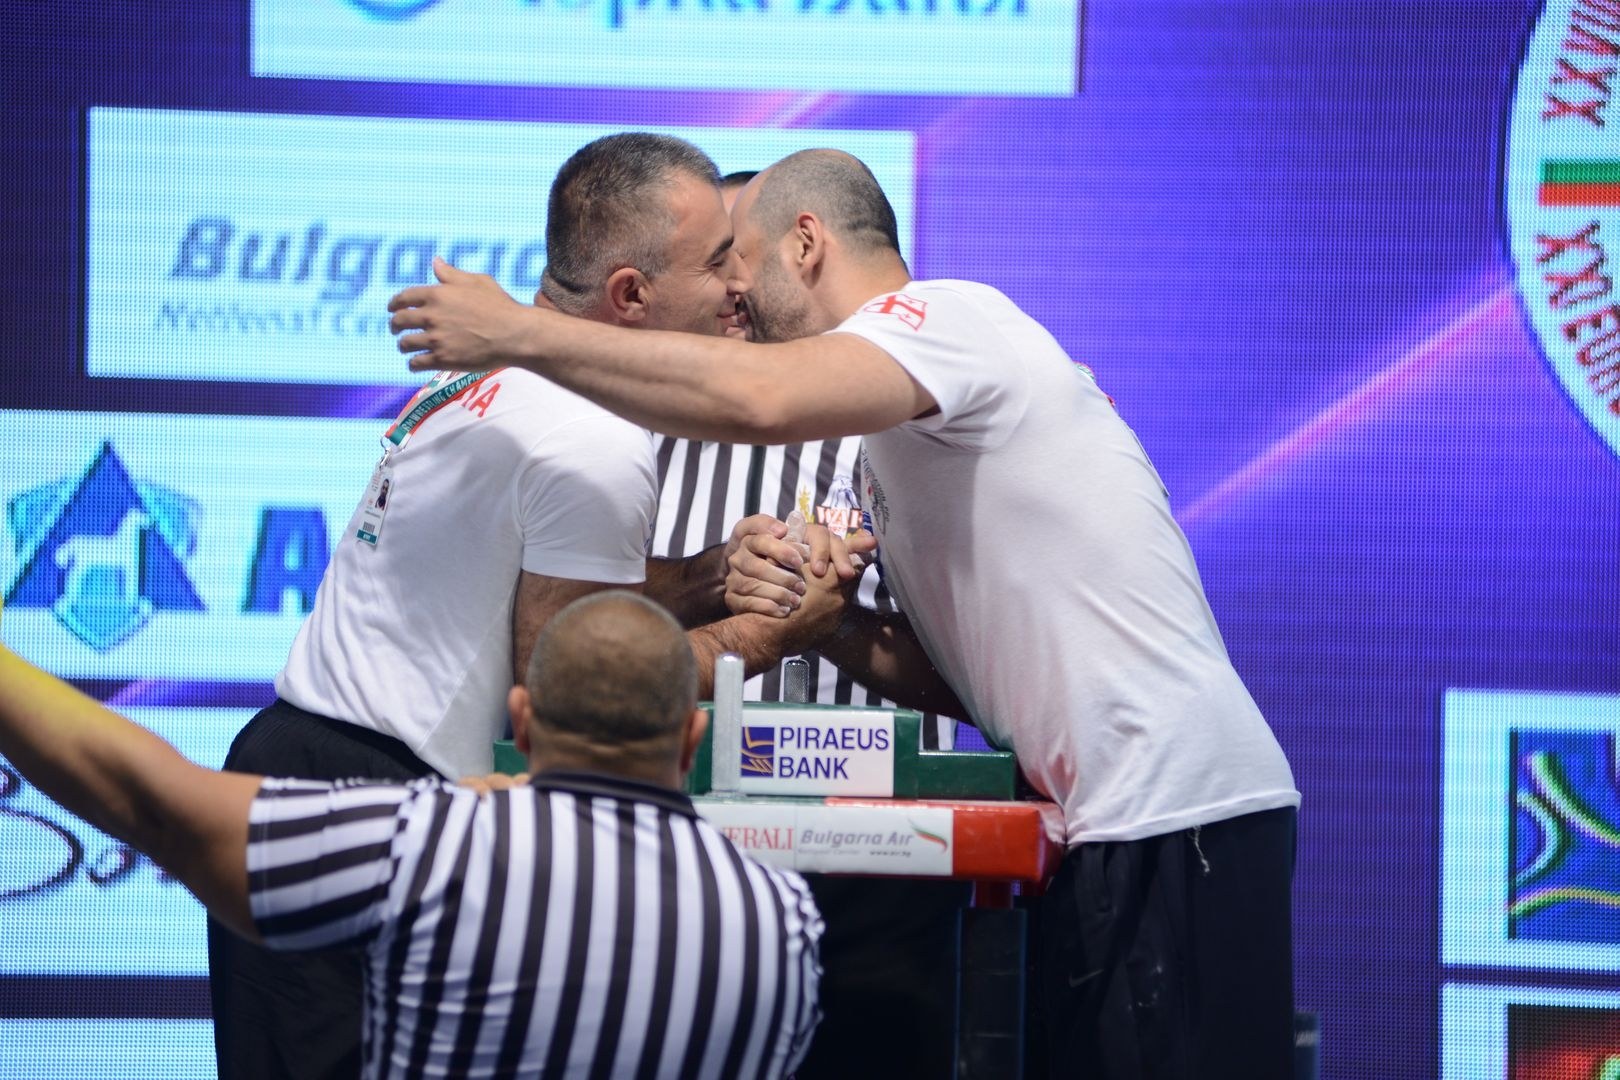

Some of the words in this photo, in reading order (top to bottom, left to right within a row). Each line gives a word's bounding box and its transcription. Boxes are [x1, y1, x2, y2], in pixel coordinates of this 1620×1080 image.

[779, 726, 890, 751] PIRAEUS
[778, 756, 849, 780] BANK
[722, 825, 795, 851] ERALI
[801, 828, 884, 849] Bulgaria
